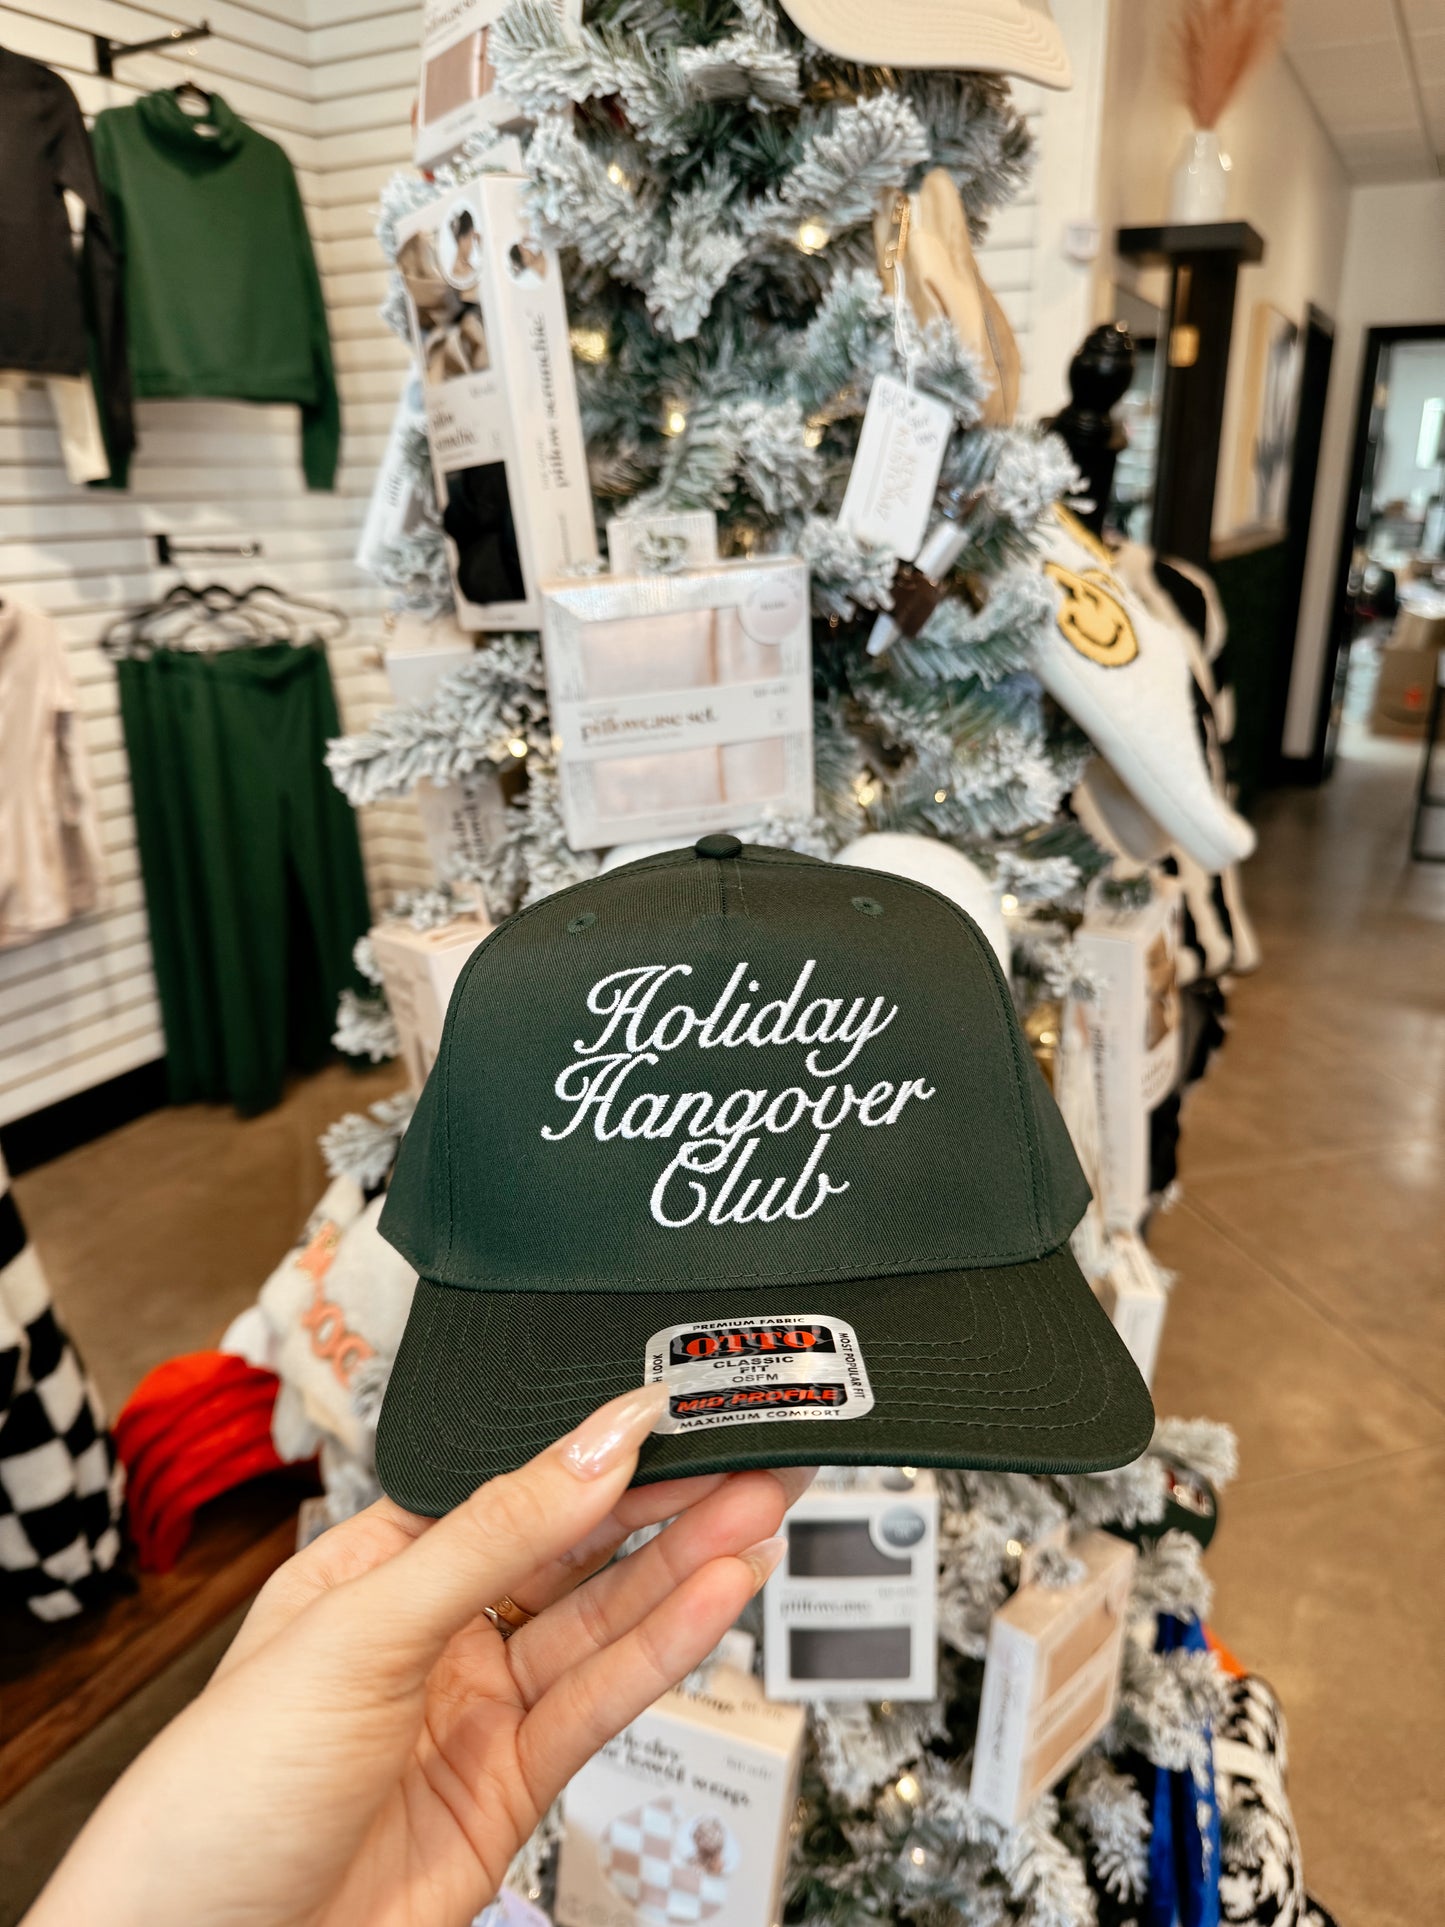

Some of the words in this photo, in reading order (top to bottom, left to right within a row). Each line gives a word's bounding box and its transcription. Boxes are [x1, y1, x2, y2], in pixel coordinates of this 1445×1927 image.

[574, 959, 898, 1077] Holiday
[540, 1053, 936, 1174] Hangover
[650, 1133, 851, 1228] Club
[692, 1320, 755, 1331] PREMIUM
[760, 1317, 805, 1325] FABRIC
[686, 1330, 816, 1357] OTTO
[838, 1332, 853, 1352] MOST
[652, 1353, 663, 1375] LOOK
[713, 1356, 794, 1369] CLASSIC
[740, 1365, 769, 1374] FIT
[844, 1353, 862, 1387] POPULAR
[732, 1373, 779, 1383] OSFM
[676, 1396, 725, 1412] MID
[731, 1389, 839, 1405] PROFILE
[853, 1388, 865, 1399] FIT
[679, 1413, 760, 1429] MAXIMUM
[766, 1409, 840, 1419] COMFORT
